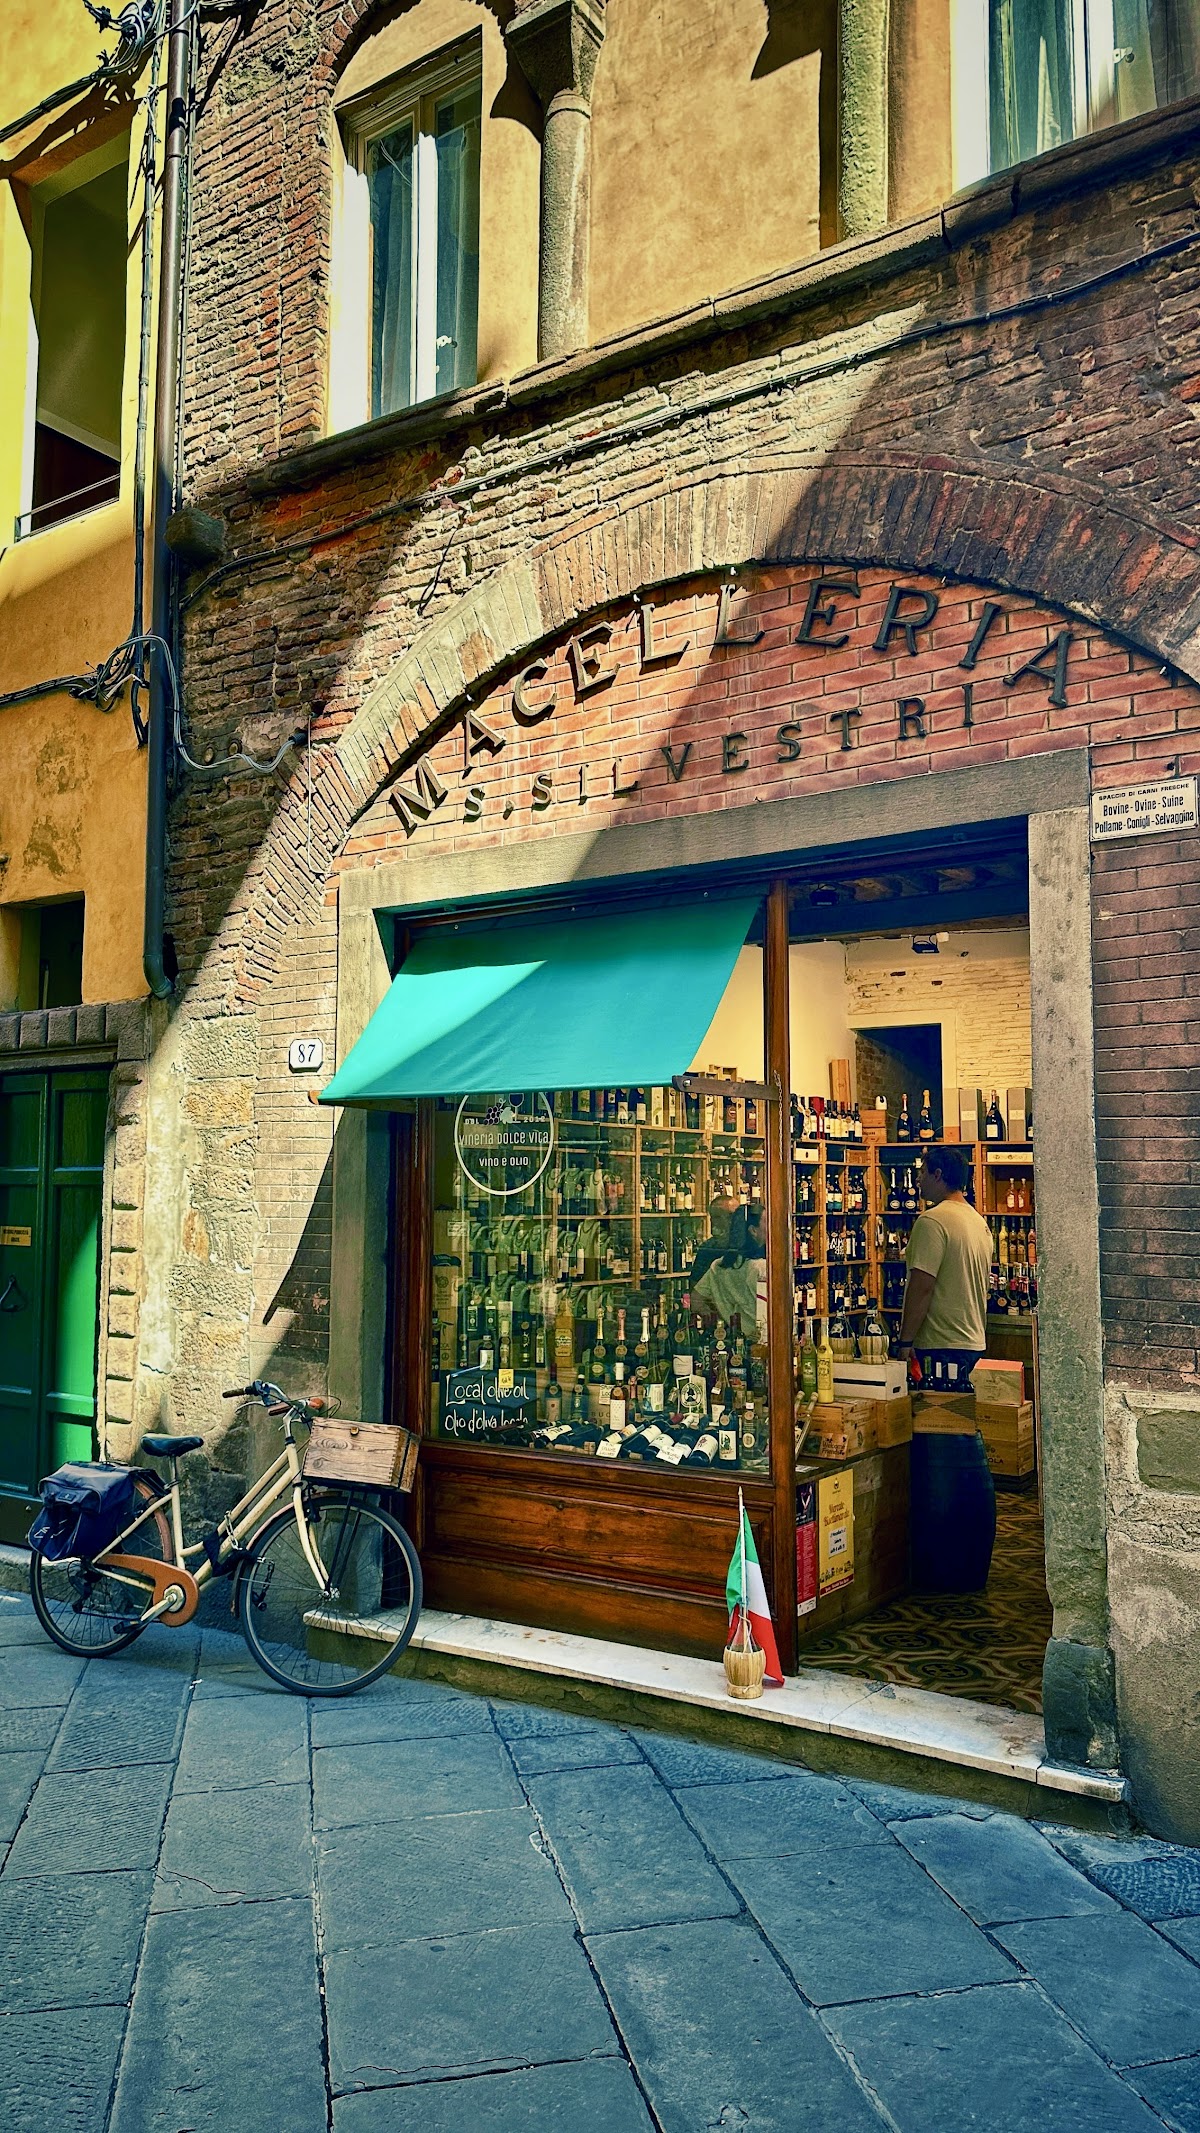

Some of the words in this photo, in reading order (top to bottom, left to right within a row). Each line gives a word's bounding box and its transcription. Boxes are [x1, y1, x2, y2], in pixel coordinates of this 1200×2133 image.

[389, 579, 1074, 833] MACELLERIA
[532, 683, 974, 808] SILVESTRI
[1098, 792, 1126, 801] SPACCIO
[1137, 788, 1158, 796] CARNI
[1160, 783, 1190, 792] FRESCHE
[1103, 803, 1129, 817] Bovine
[1134, 799, 1157, 812] Ovine
[1162, 795, 1184, 808] Suine
[1095, 820, 1123, 834] Pollame
[1126, 815, 1151, 830] Conigli
[1155, 809, 1195, 826] Selvaggina
[298, 1043, 316, 1064] 87
[501, 1157, 508, 1166] e
[445, 1374, 487, 1407] Local
[513, 1376, 530, 1400] oil
[822, 1441, 846, 1449] Welcome
